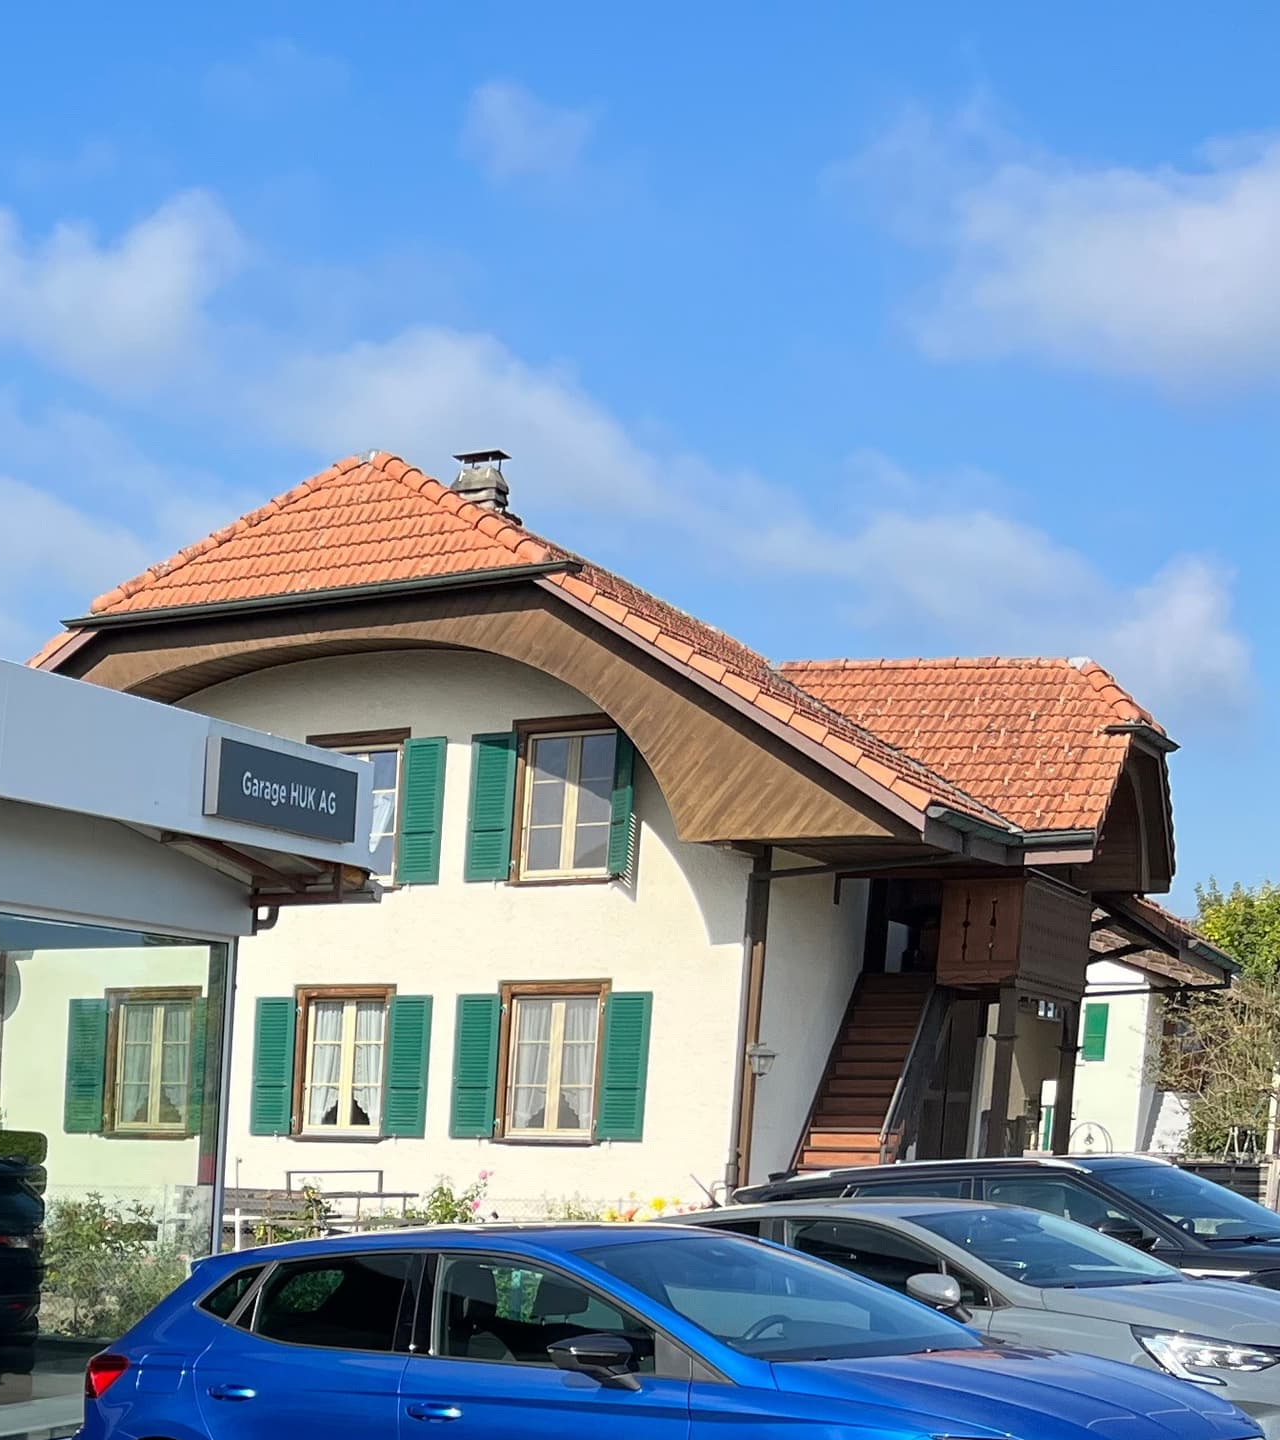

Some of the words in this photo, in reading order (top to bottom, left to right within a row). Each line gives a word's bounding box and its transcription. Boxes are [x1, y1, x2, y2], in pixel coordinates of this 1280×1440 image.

[242, 771, 286, 806] Garage
[290, 782, 316, 811] HUK
[318, 790, 336, 815] AG
